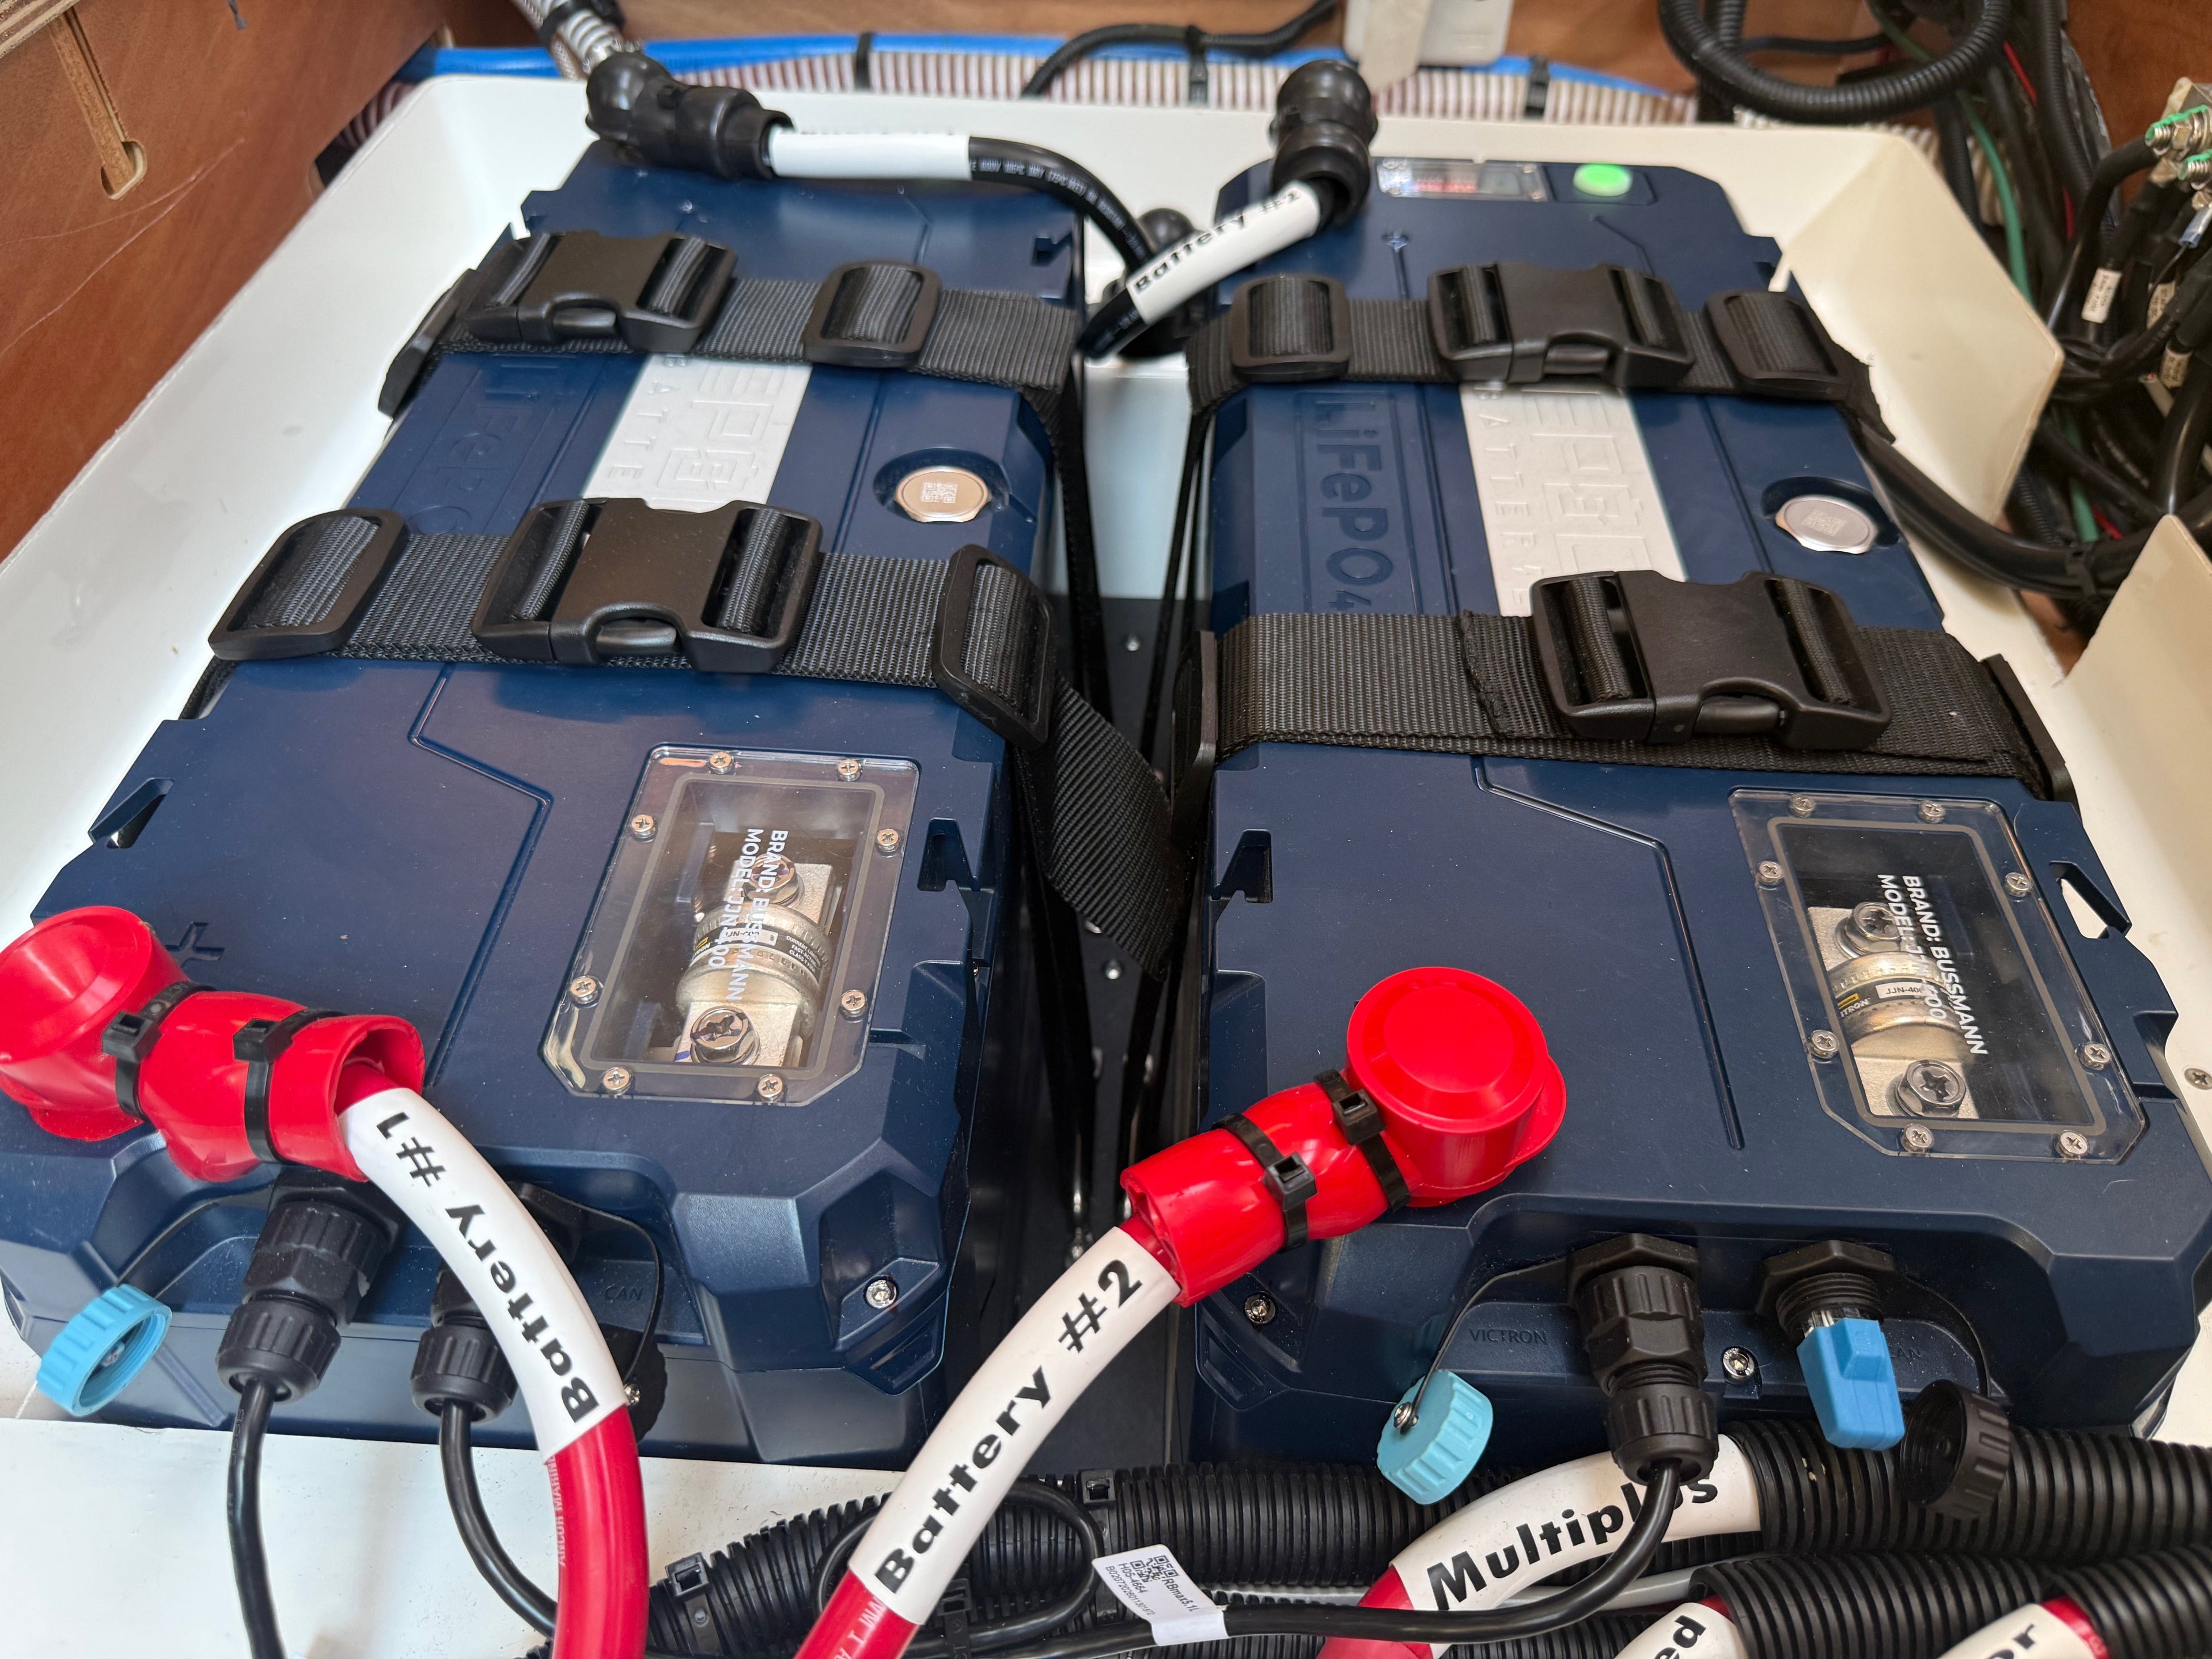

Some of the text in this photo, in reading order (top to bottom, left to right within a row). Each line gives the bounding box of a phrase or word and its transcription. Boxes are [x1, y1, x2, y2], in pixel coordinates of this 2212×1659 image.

[1133, 214, 1248, 294] Battery
[1315, 400, 1393, 612] LiFePO4
[731, 828, 764, 892] MODEL:
[1877, 874, 1914, 941] MODEL:
[726, 830, 789, 1001] BRAND: BUSSMANN
[789, 949, 804, 961] CLASS
[1902, 876, 1988, 1054] BRAND: BUSSMANN
[376, 1112, 600, 1423] Battery #1
[605, 1284, 643, 1301] CAN
[1469, 1328, 1550, 1346] VICTRON
[874, 1259, 1143, 1594] Battery #2
[1426, 1475, 1718, 1612] Multipls
